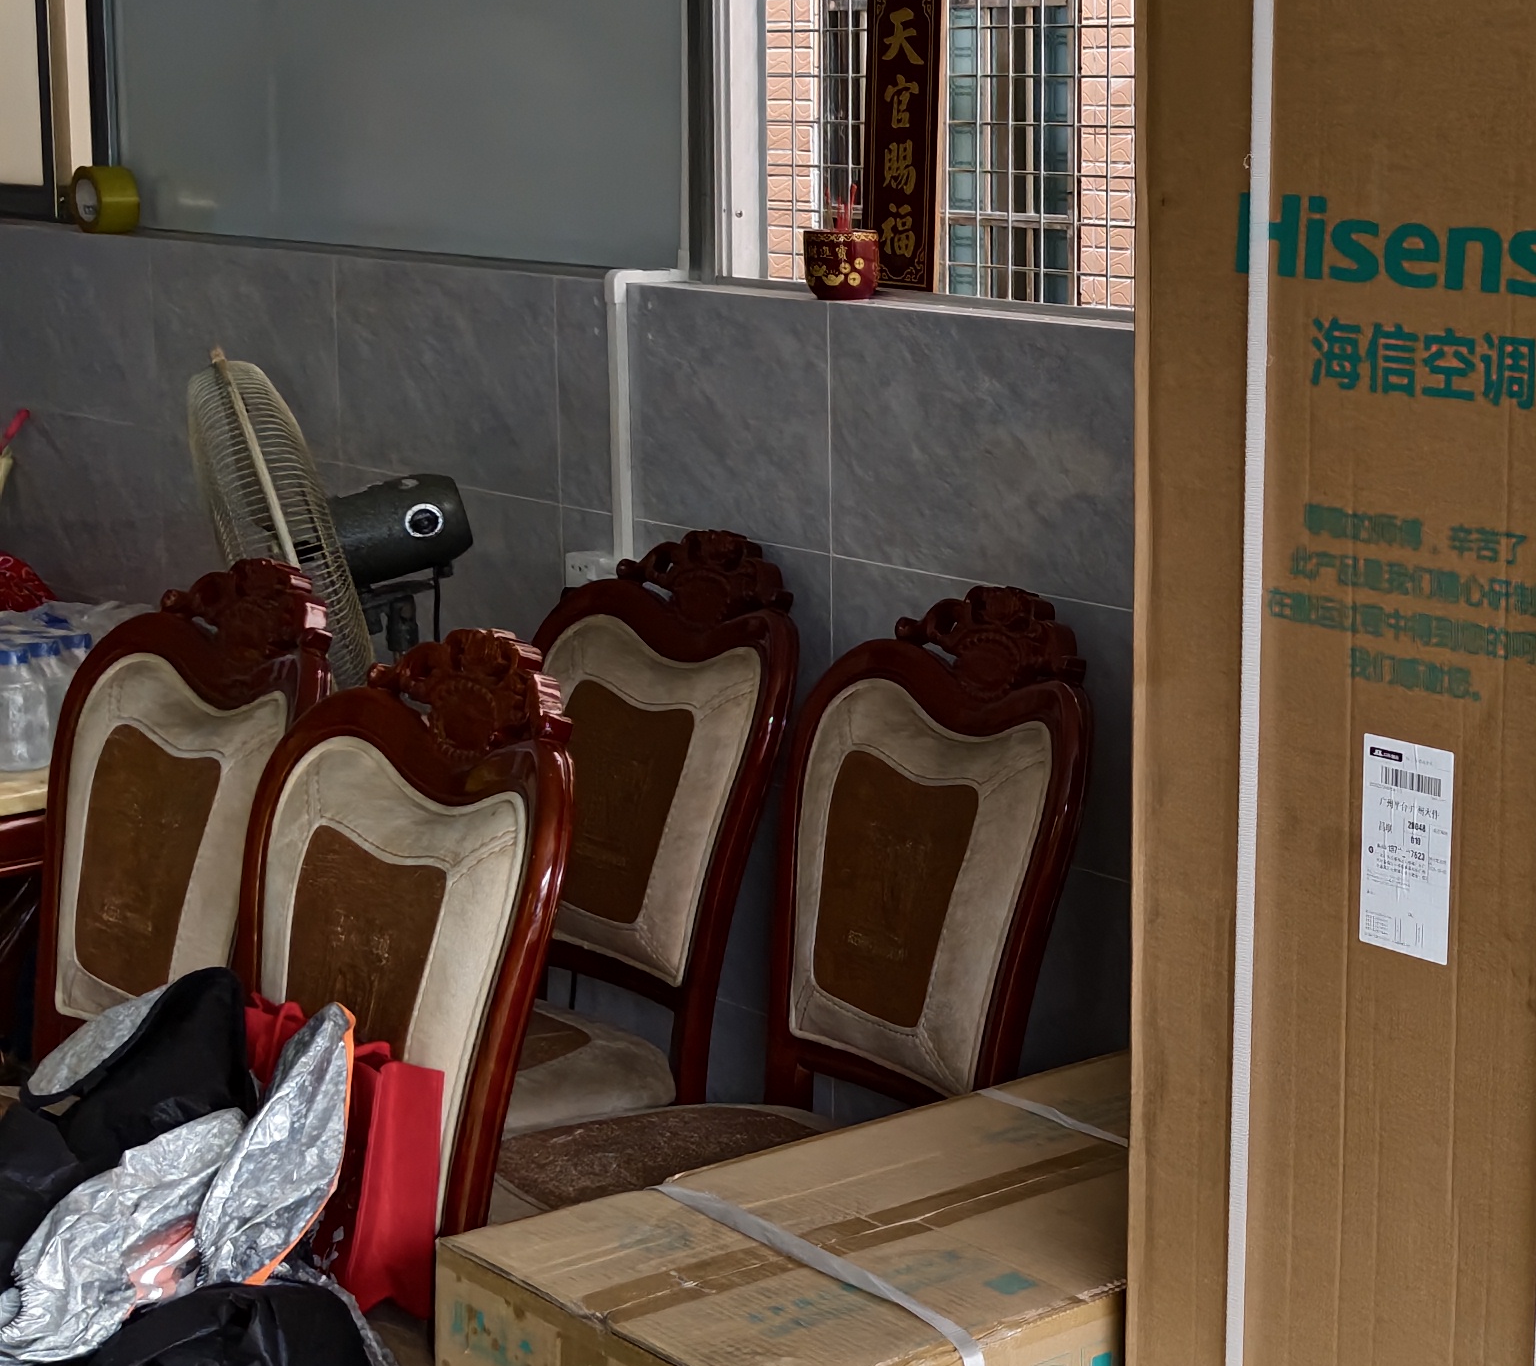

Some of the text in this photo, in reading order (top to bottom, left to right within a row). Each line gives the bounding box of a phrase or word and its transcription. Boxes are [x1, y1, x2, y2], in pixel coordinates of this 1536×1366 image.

[880, 6, 925, 259] 天官賜福
[1310, 316, 1536, 410] 海信空调
